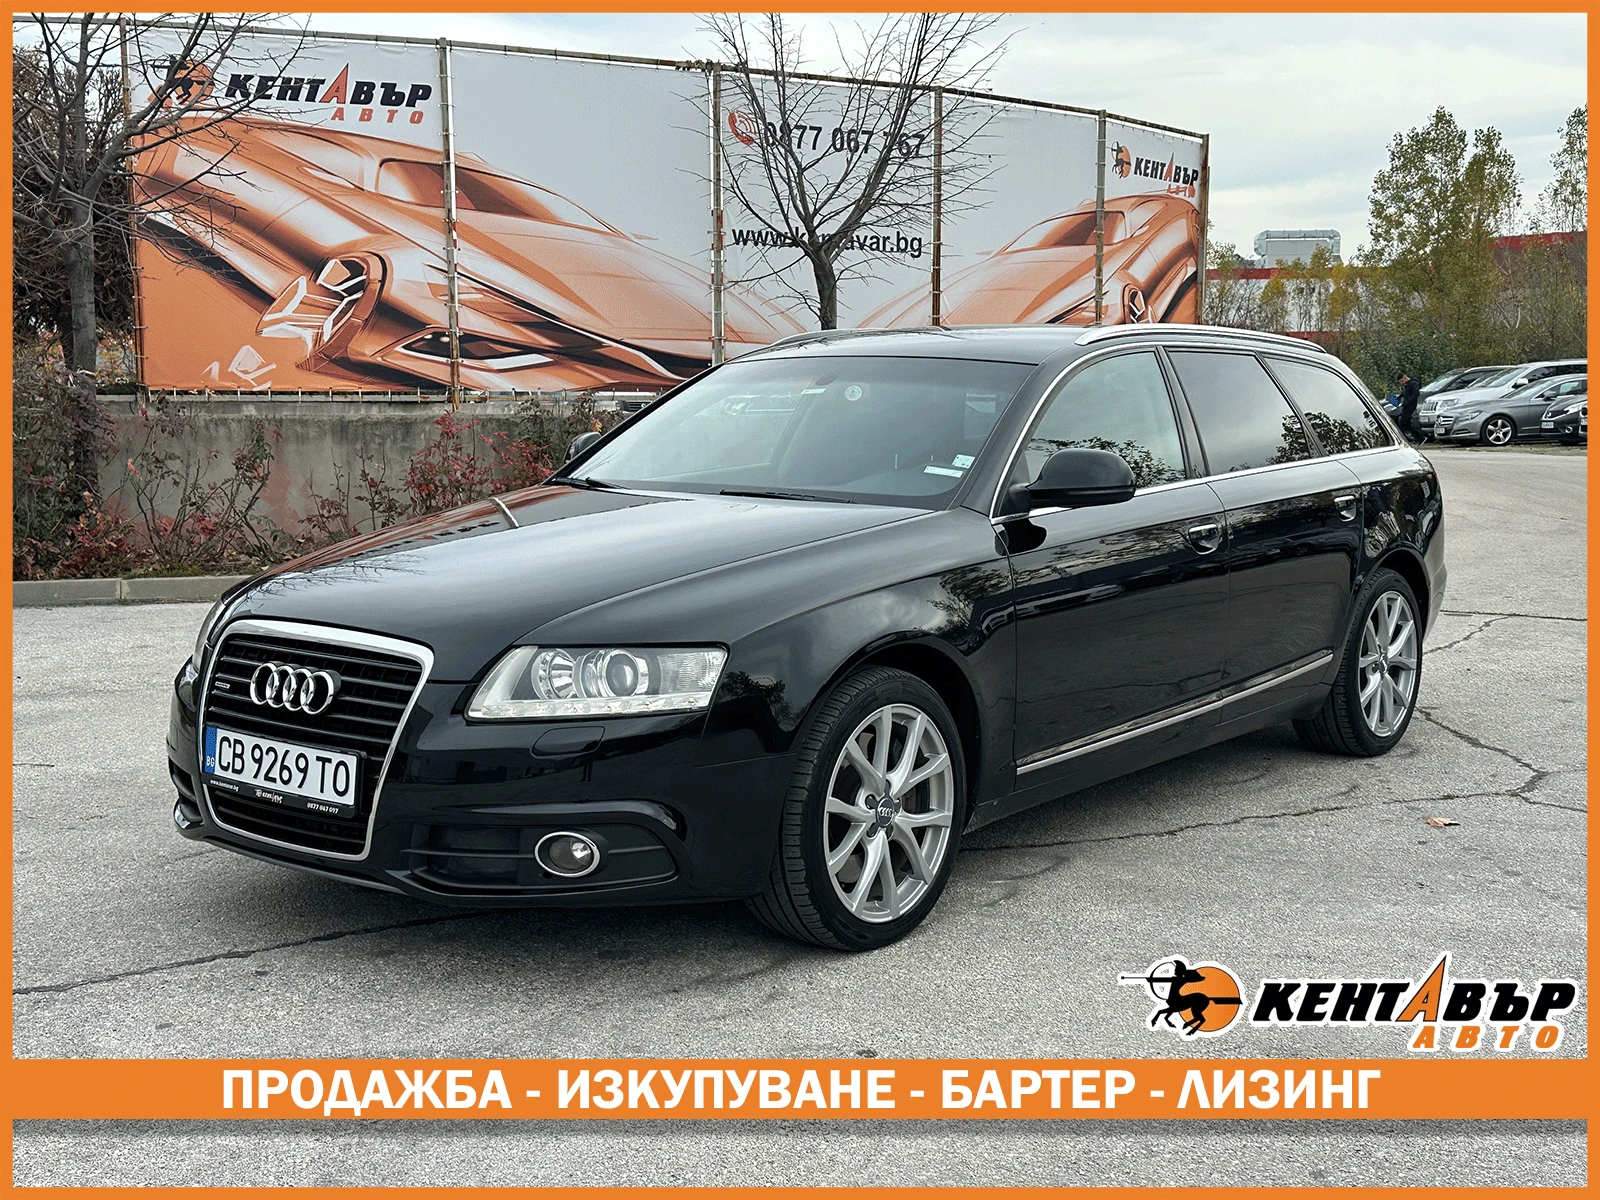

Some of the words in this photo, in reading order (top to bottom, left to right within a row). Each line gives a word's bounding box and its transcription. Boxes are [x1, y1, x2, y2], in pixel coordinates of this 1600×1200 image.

[225, 63, 432, 108] КЕНТАВЪР
[330, 106, 424, 125] АВТО
[831, 127, 873, 154] 067
[1134, 152, 1199, 186] КЕНТАВЪР
[206, 755, 215, 767] BG
[218, 735, 245, 775] CB
[250, 743, 309, 789] 9269
